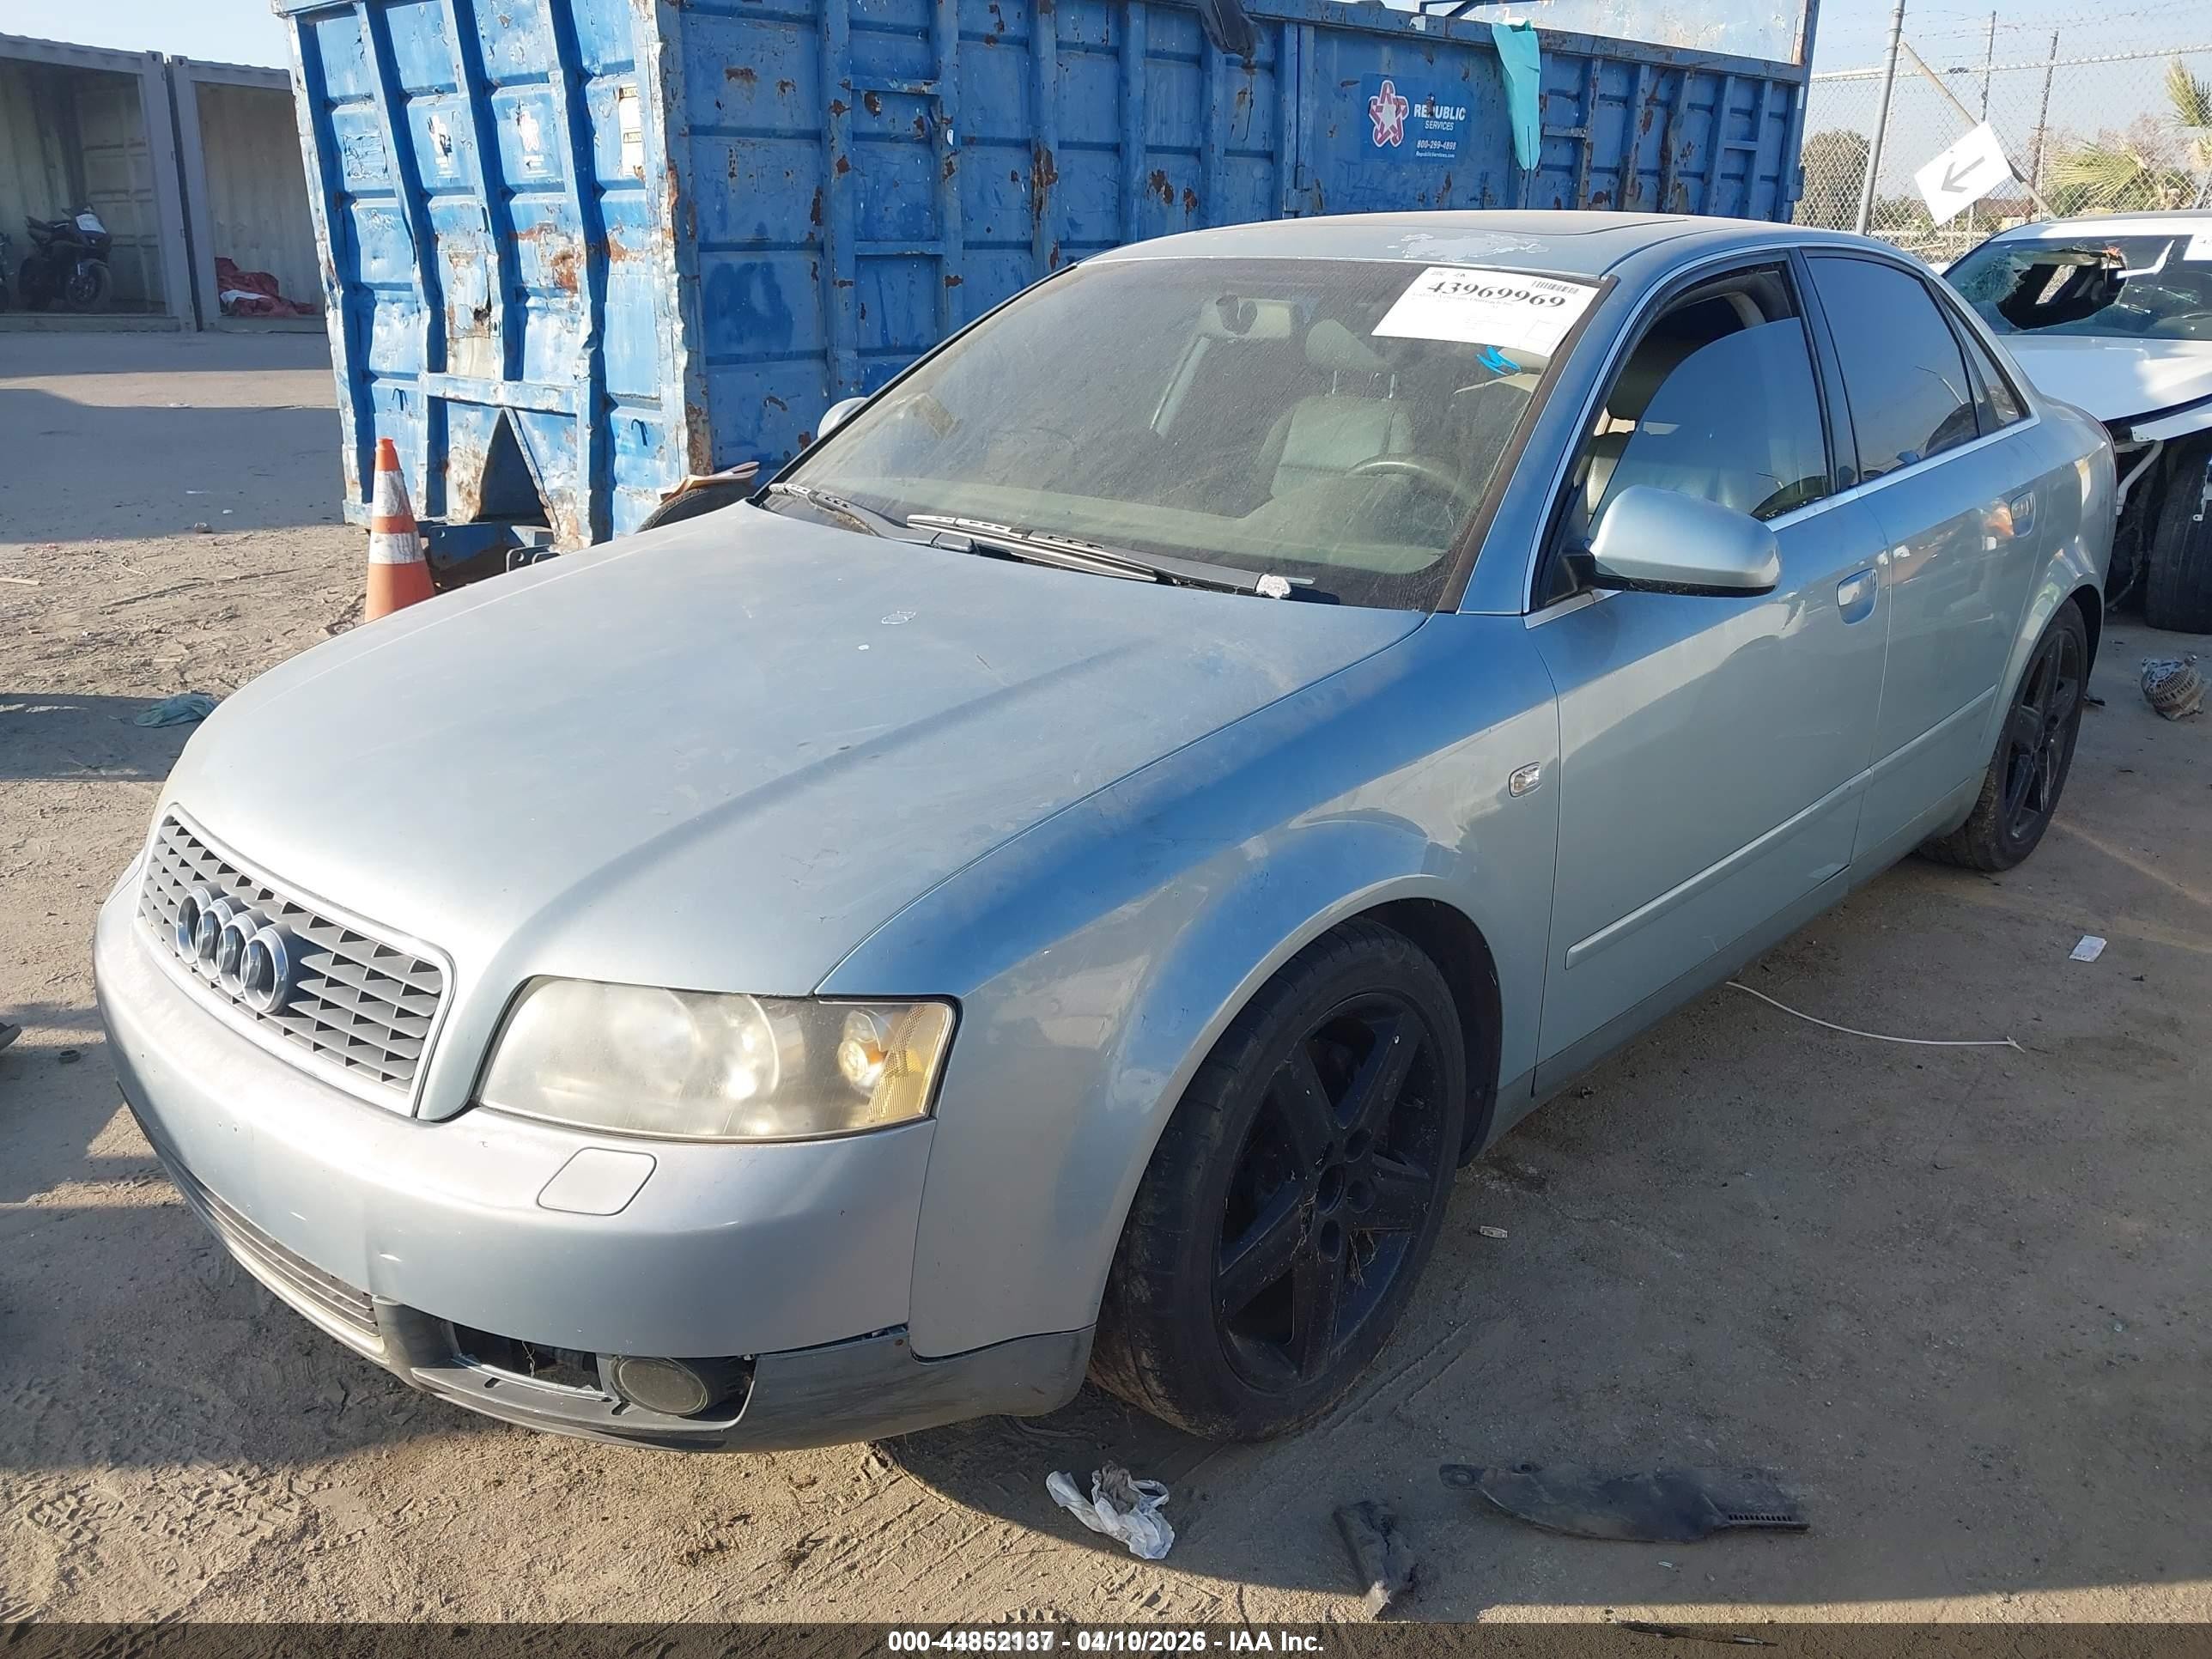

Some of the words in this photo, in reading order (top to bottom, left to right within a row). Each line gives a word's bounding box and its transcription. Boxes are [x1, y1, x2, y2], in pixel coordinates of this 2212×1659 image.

[1414, 104, 1466, 120] REUBLIC
[1425, 121, 1454, 131] SERVICES
[1427, 281, 1566, 307] 43969969
